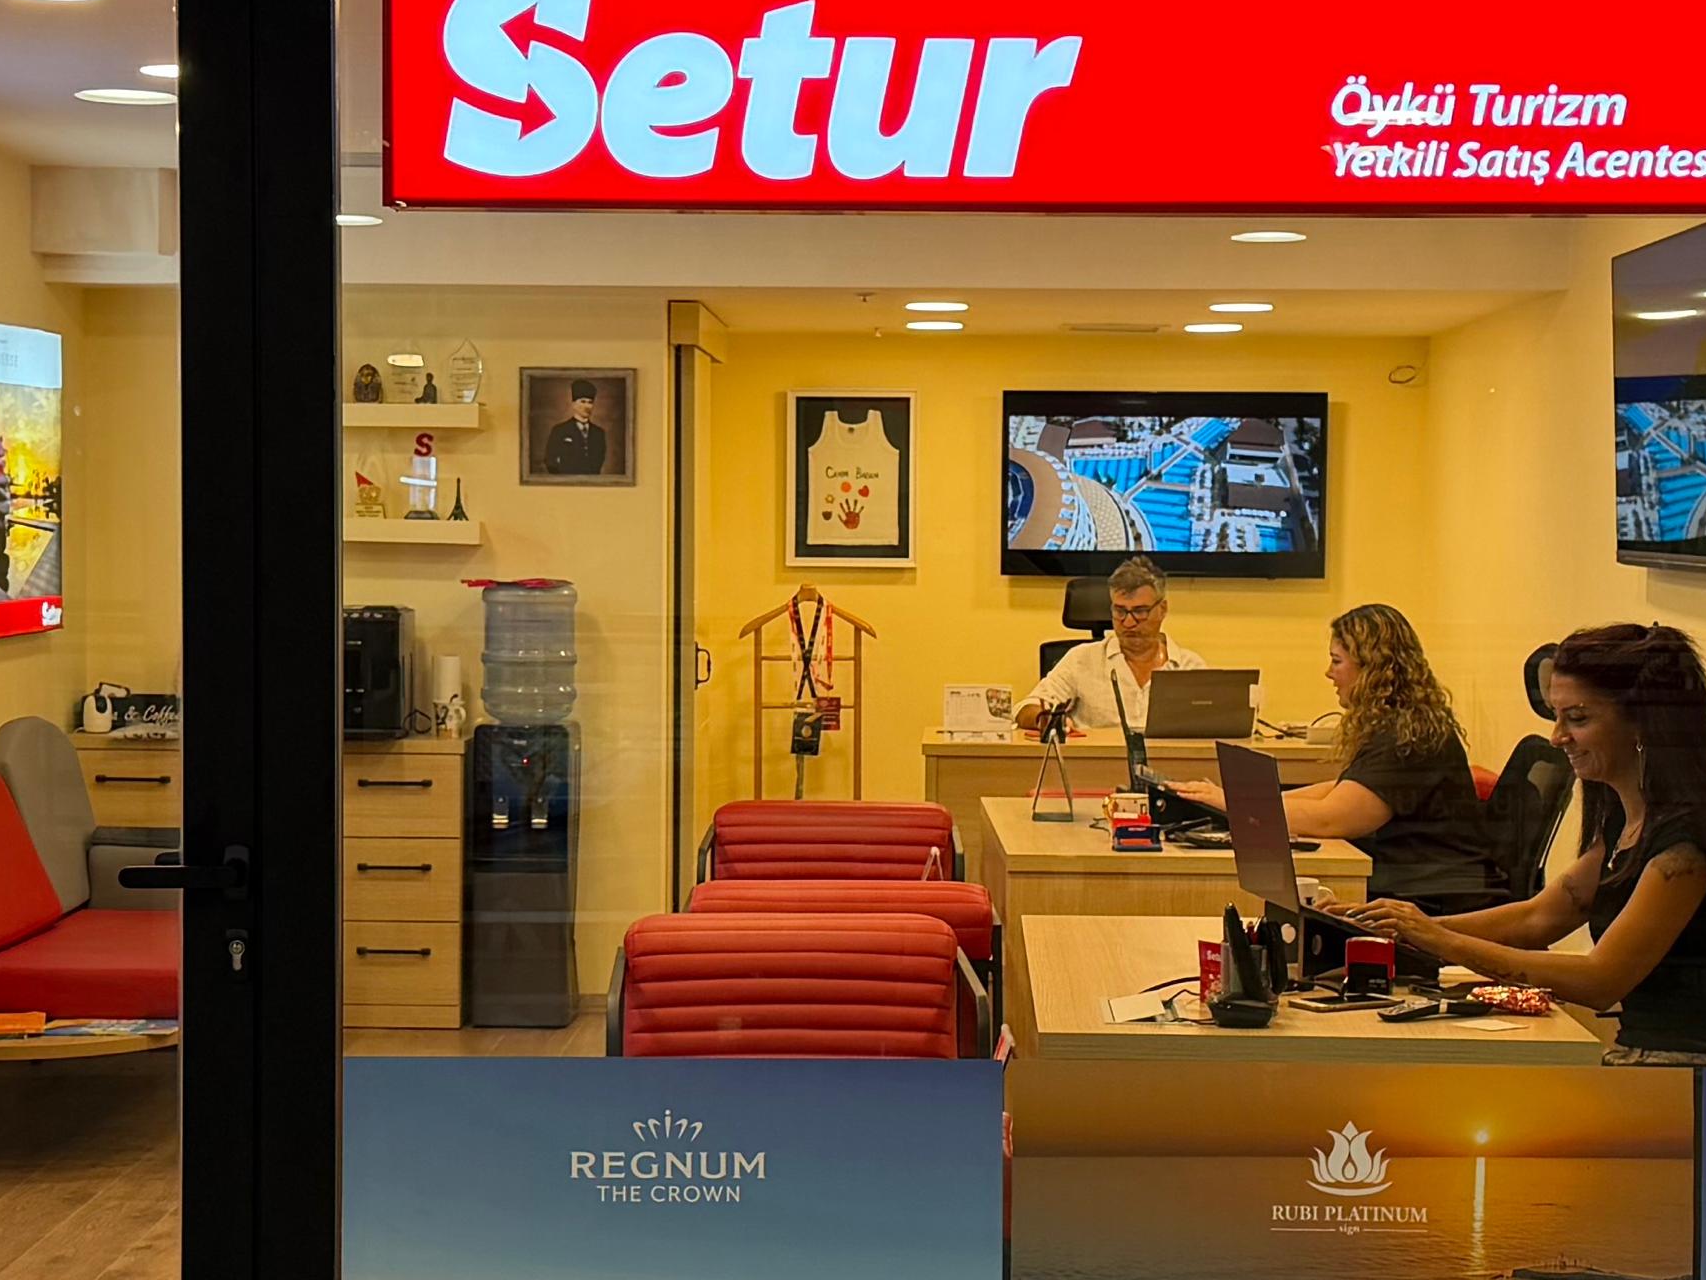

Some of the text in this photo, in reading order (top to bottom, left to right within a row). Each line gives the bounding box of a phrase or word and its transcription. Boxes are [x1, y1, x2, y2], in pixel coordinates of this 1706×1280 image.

[1331, 75, 1628, 137] Öykü Turizm
[1332, 141, 1450, 178] Yetkili
[1453, 141, 1550, 186] Satış
[570, 1151, 766, 1179] REGNUM
[596, 1185, 741, 1203] THE CROWN
[1272, 1205, 1428, 1223] RUBI PLATINUM
[1339, 1225, 1361, 1236] sign
